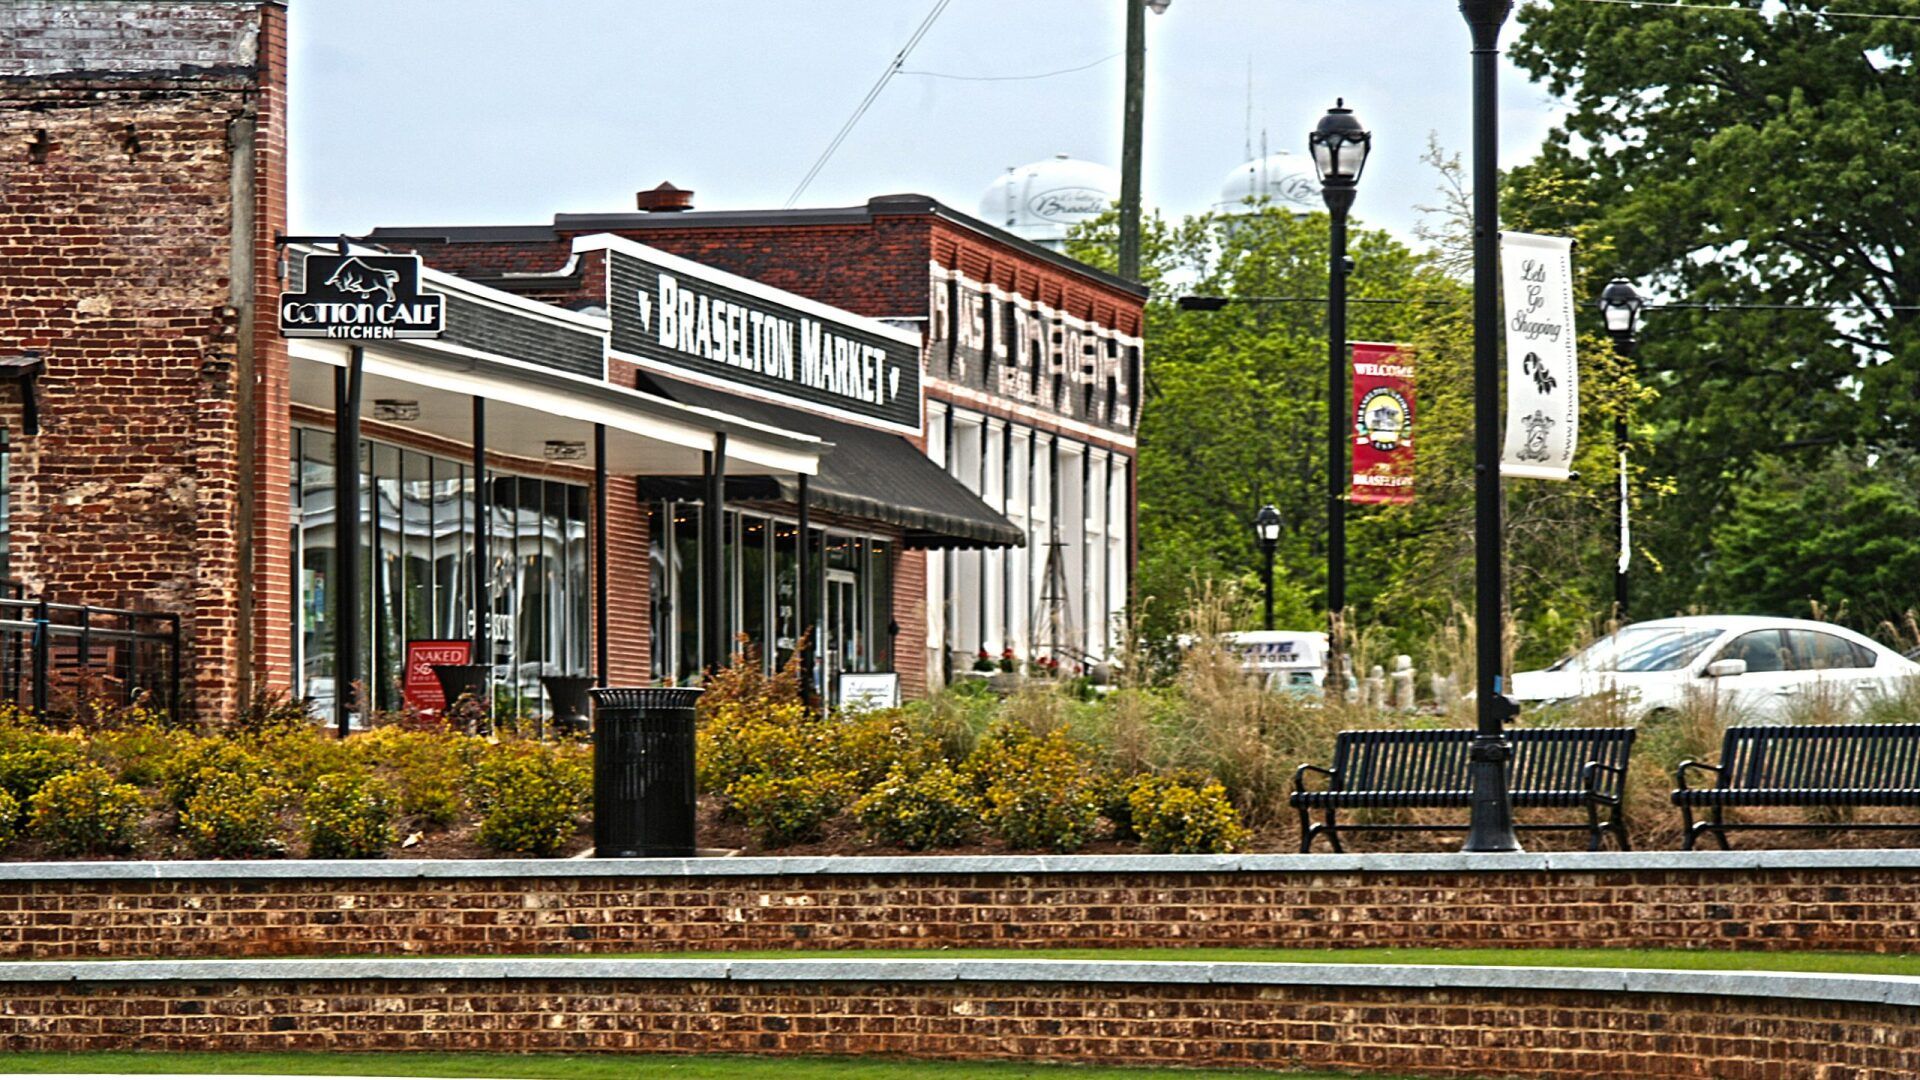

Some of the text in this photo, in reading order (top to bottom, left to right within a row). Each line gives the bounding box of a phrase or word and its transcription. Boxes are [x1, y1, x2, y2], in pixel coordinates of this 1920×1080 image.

[1526, 285, 1545, 314] Go
[283, 302, 439, 324] COTTON CALF
[327, 326, 394, 339] KITCHEN
[1511, 309, 1562, 343] Shopping
[658, 273, 794, 382] BRASELTON
[800, 317, 887, 406] MARKET
[1353, 363, 1415, 378] WELCOME
[413, 650, 463, 663] NAKED
